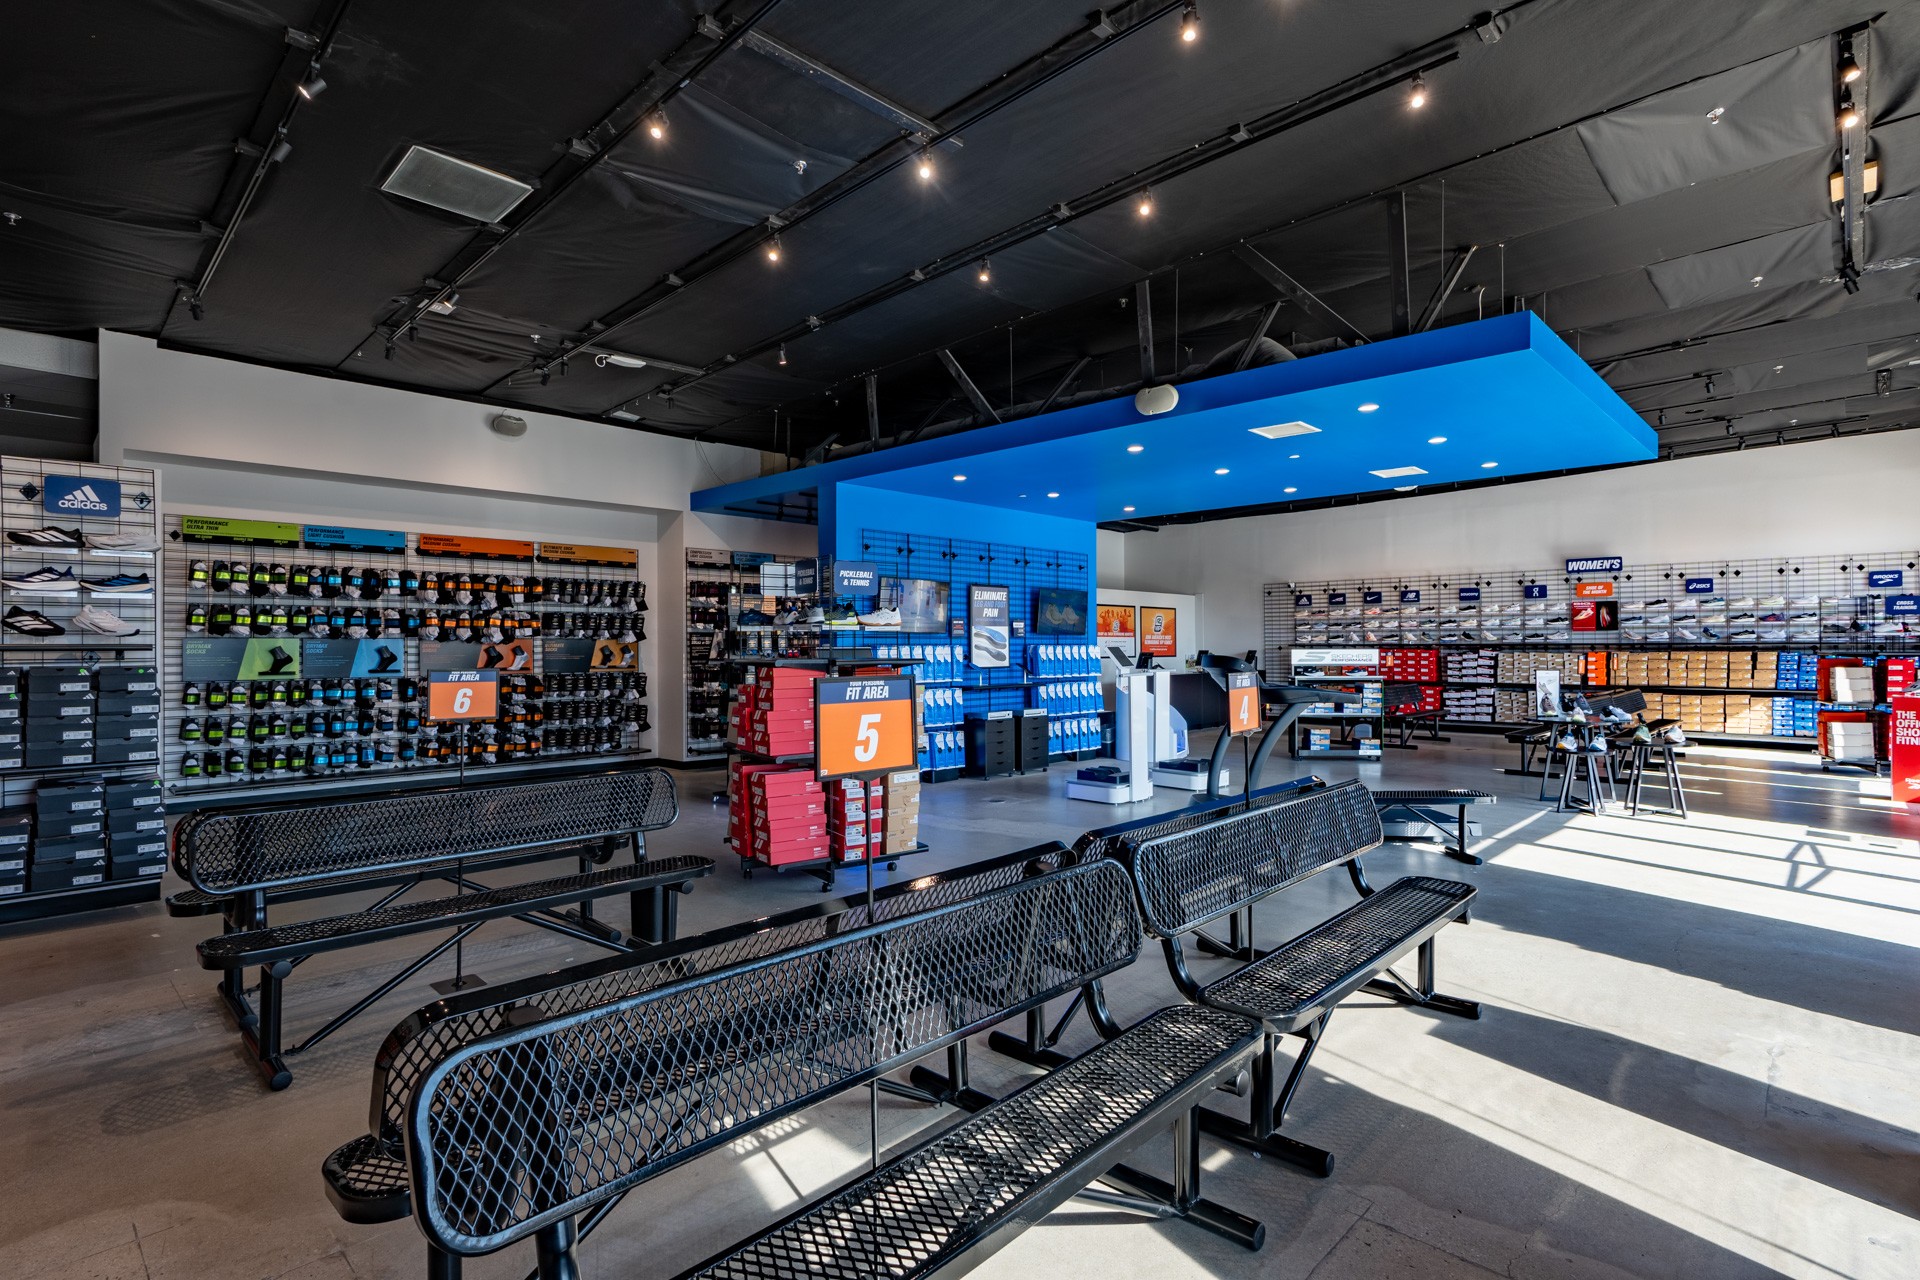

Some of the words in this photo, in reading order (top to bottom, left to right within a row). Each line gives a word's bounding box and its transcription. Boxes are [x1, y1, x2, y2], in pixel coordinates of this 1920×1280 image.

[58, 499, 108, 511] adidas
[186, 519, 229, 527] PERFORMANCE
[308, 527, 344, 535] PERFORMANCE
[1568, 559, 1621, 571] WOMEN'S
[797, 568, 815, 577] PICKLEBALL
[839, 570, 873, 578] PICKLEBALL
[974, 591, 1007, 600] ELIMINATE
[983, 608, 999, 617] PAIN
[845, 687, 861, 700] FIT
[862, 686, 889, 699] AREA
[453, 688, 473, 713] 6
[1240, 695, 1248, 725] 4
[1896, 711, 1916, 719] THE
[1896, 720, 1920, 728] OFFI
[854, 713, 881, 762] 5
